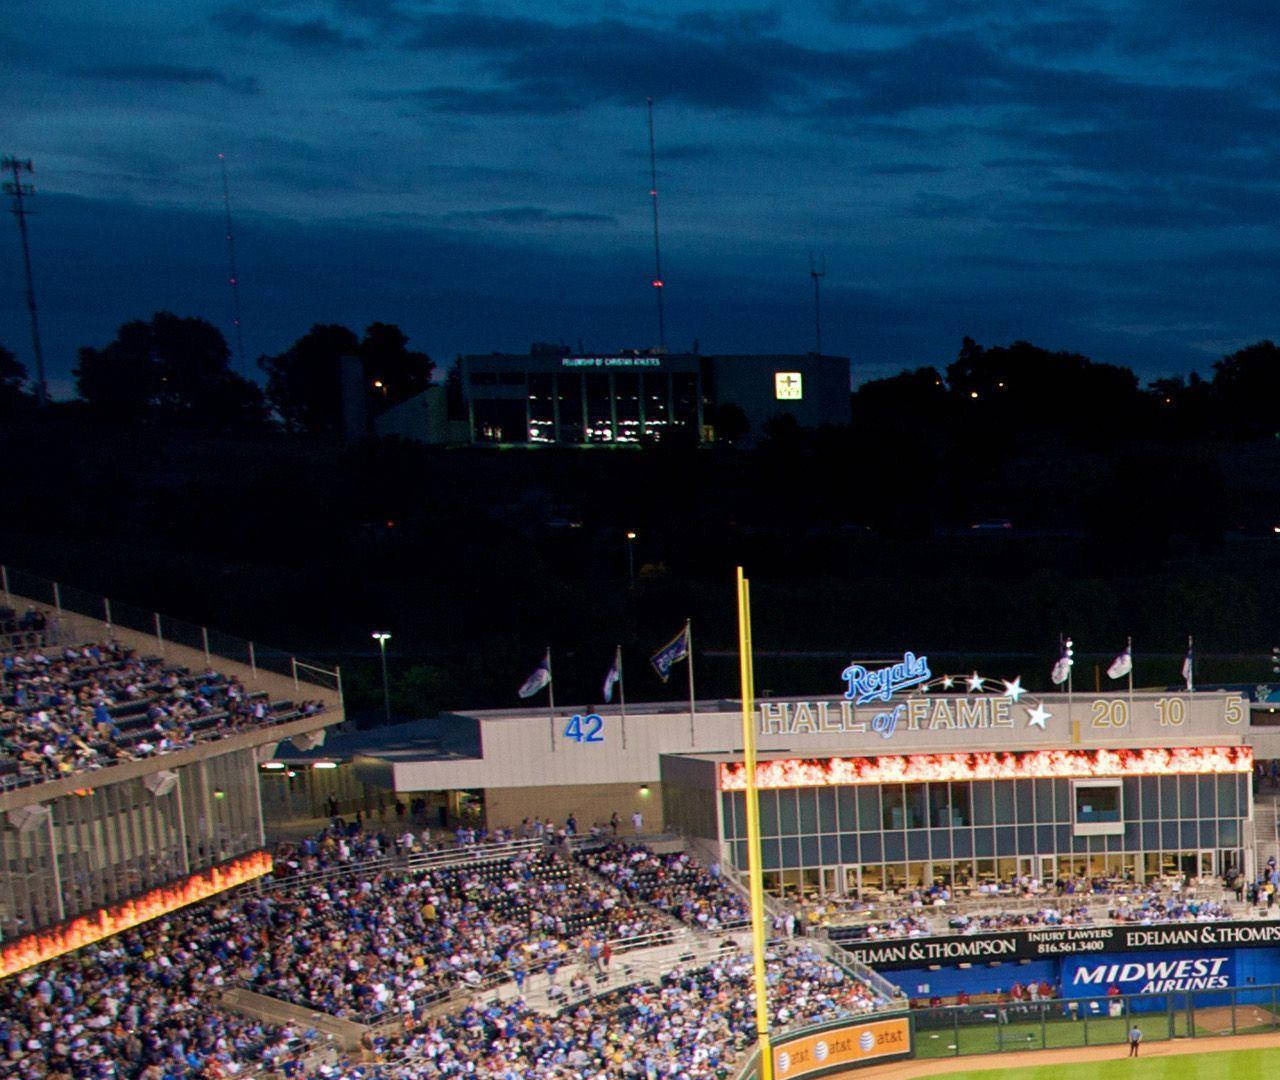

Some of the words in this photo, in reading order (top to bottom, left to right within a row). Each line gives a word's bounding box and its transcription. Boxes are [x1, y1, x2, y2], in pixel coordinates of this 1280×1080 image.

[842, 652, 931, 705] Royals
[760, 700, 866, 735] HALL
[872, 704, 906, 740] of
[906, 696, 1015, 731] FAME
[1091, 700, 1128, 728] 20
[1154, 697, 1185, 726] 10
[1224, 696, 1243, 725] 5
[563, 713, 604, 743] 42
[908, 943, 924, 961] &
[925, 938, 1017, 958] THOMPSON
[1027, 931, 1065, 943] INJURY
[1067, 929, 1114, 941] LAWYERS
[1126, 929, 1199, 947] EDELMAN
[1200, 926, 1216, 944] &
[1073, 957, 1230, 986] MIDWEST
[1140, 975, 1231, 994] AIRLINES
